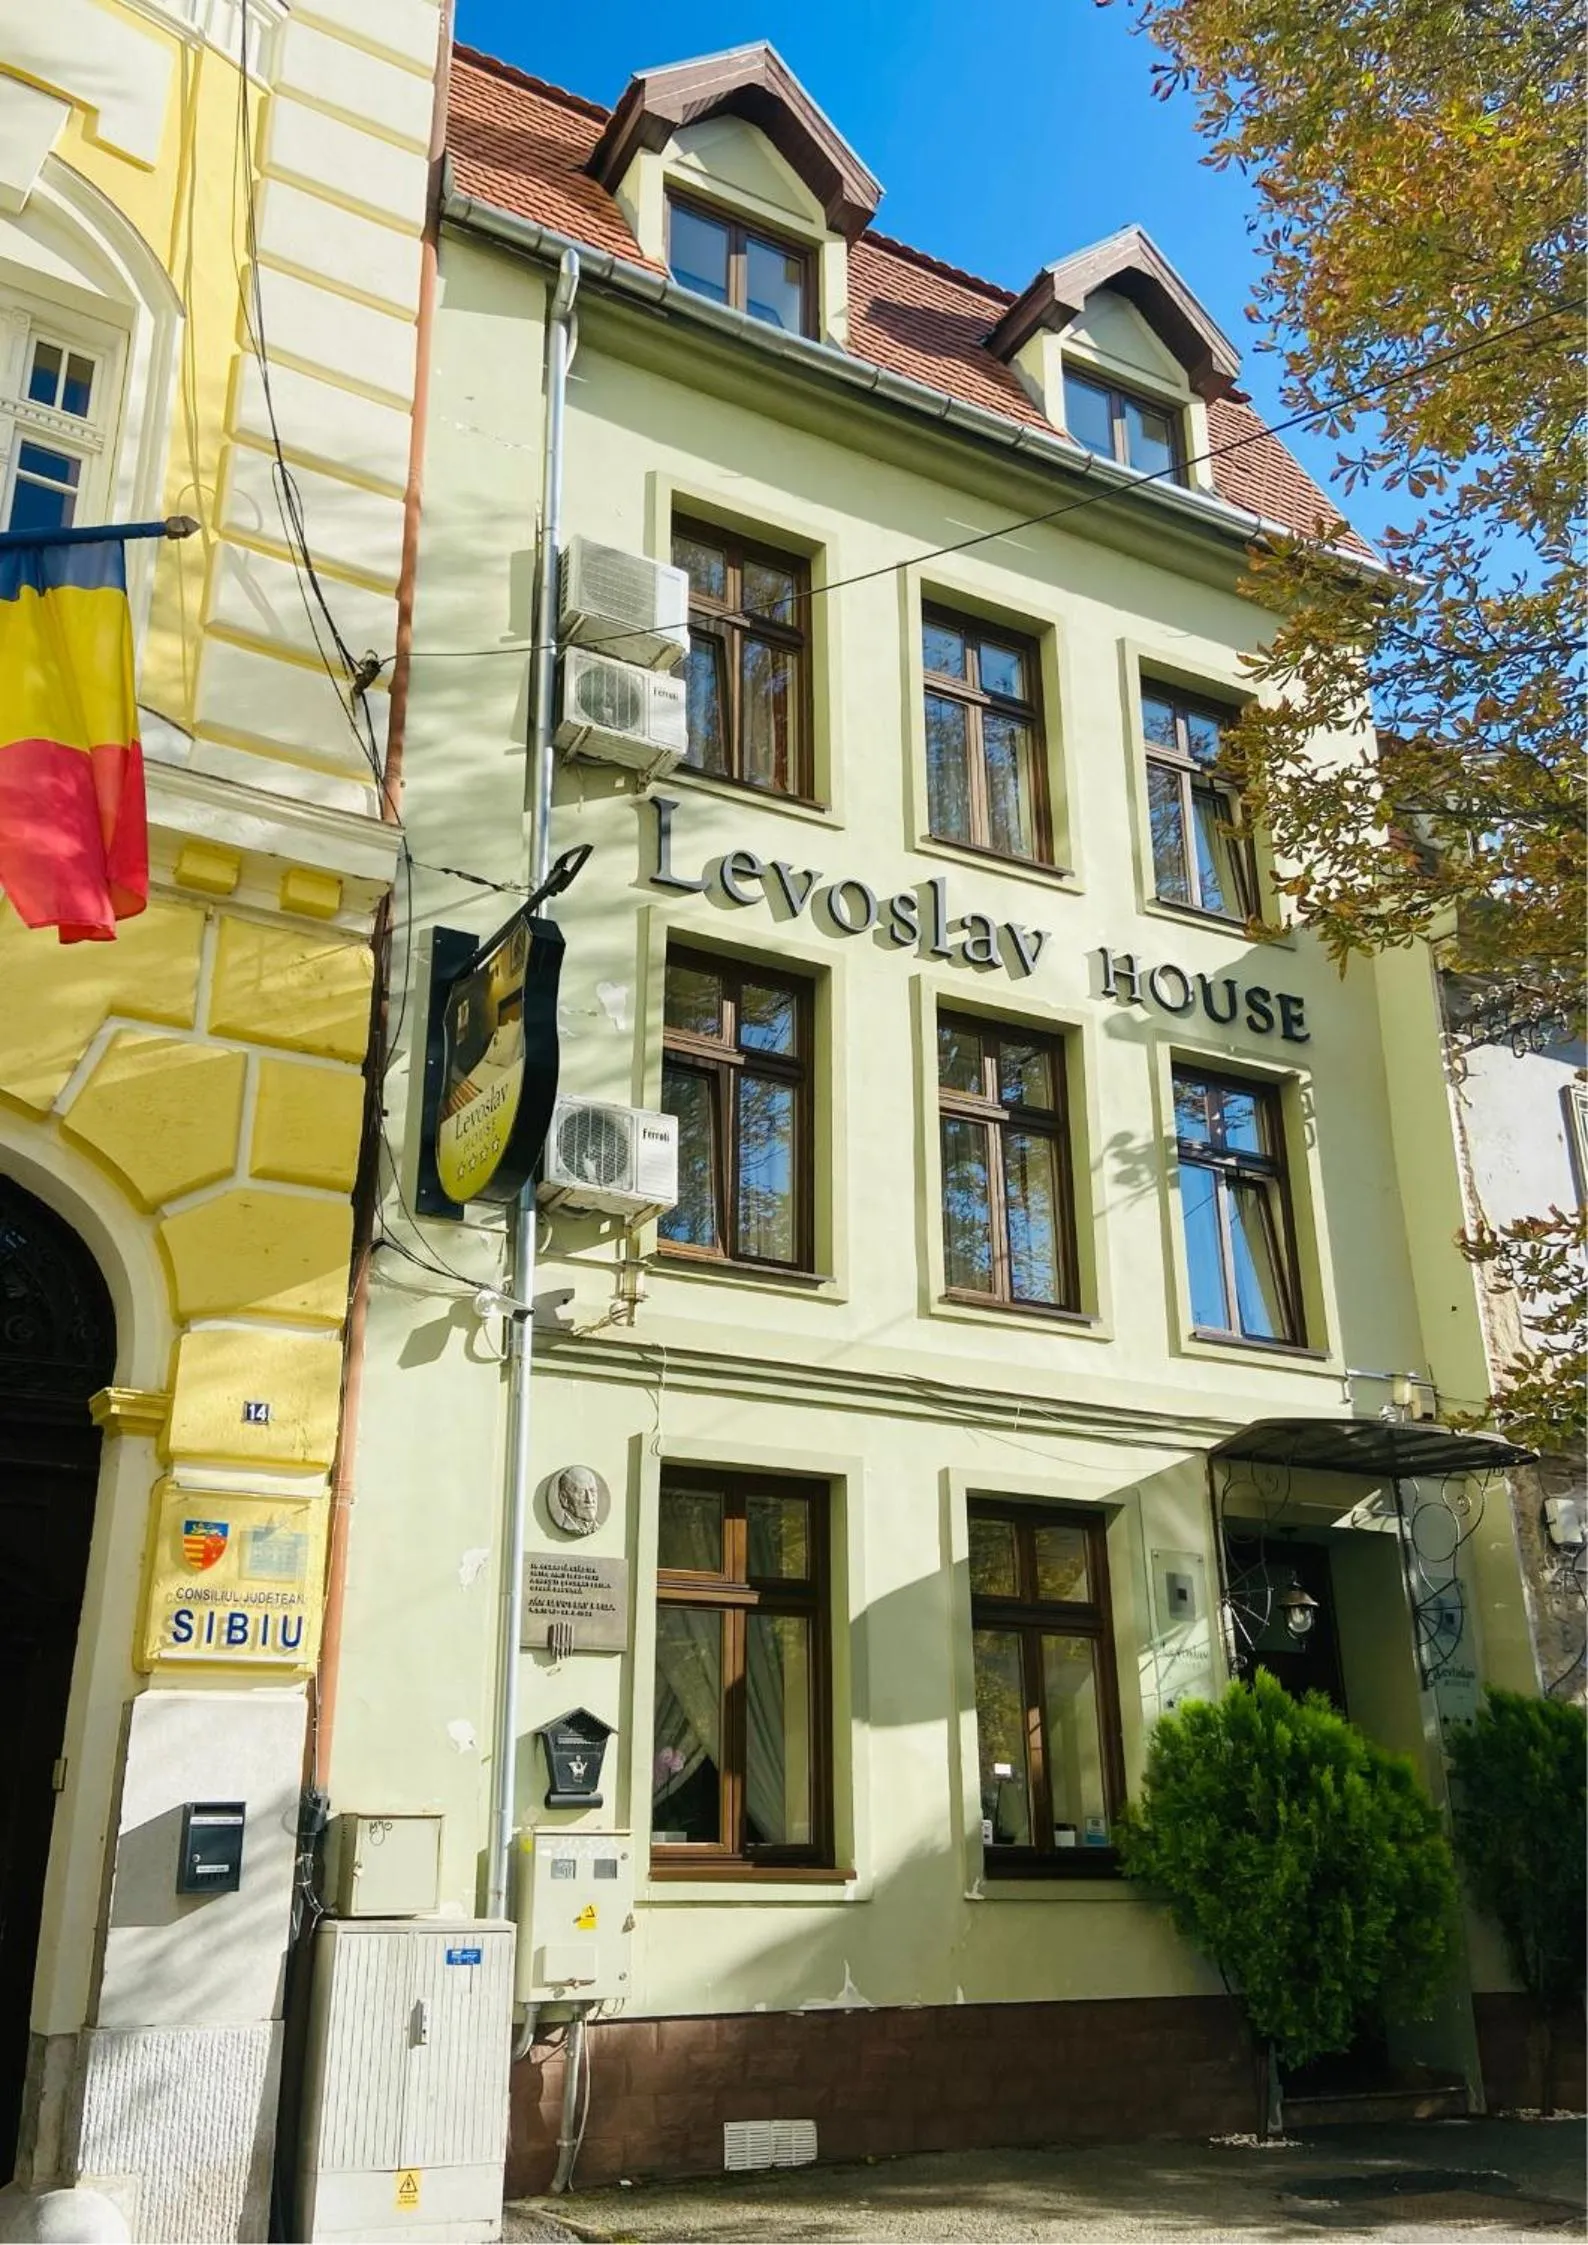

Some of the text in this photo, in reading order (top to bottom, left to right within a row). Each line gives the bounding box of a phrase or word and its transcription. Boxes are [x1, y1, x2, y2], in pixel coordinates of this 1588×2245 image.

[649, 796, 1311, 1043] Levoslav HOUSE
[455, 1082, 509, 1140] Levoslav
[249, 1404, 267, 1421] 14
[175, 1586, 240, 1602] CONSILIUL
[172, 1608, 303, 1648] SIBIU
